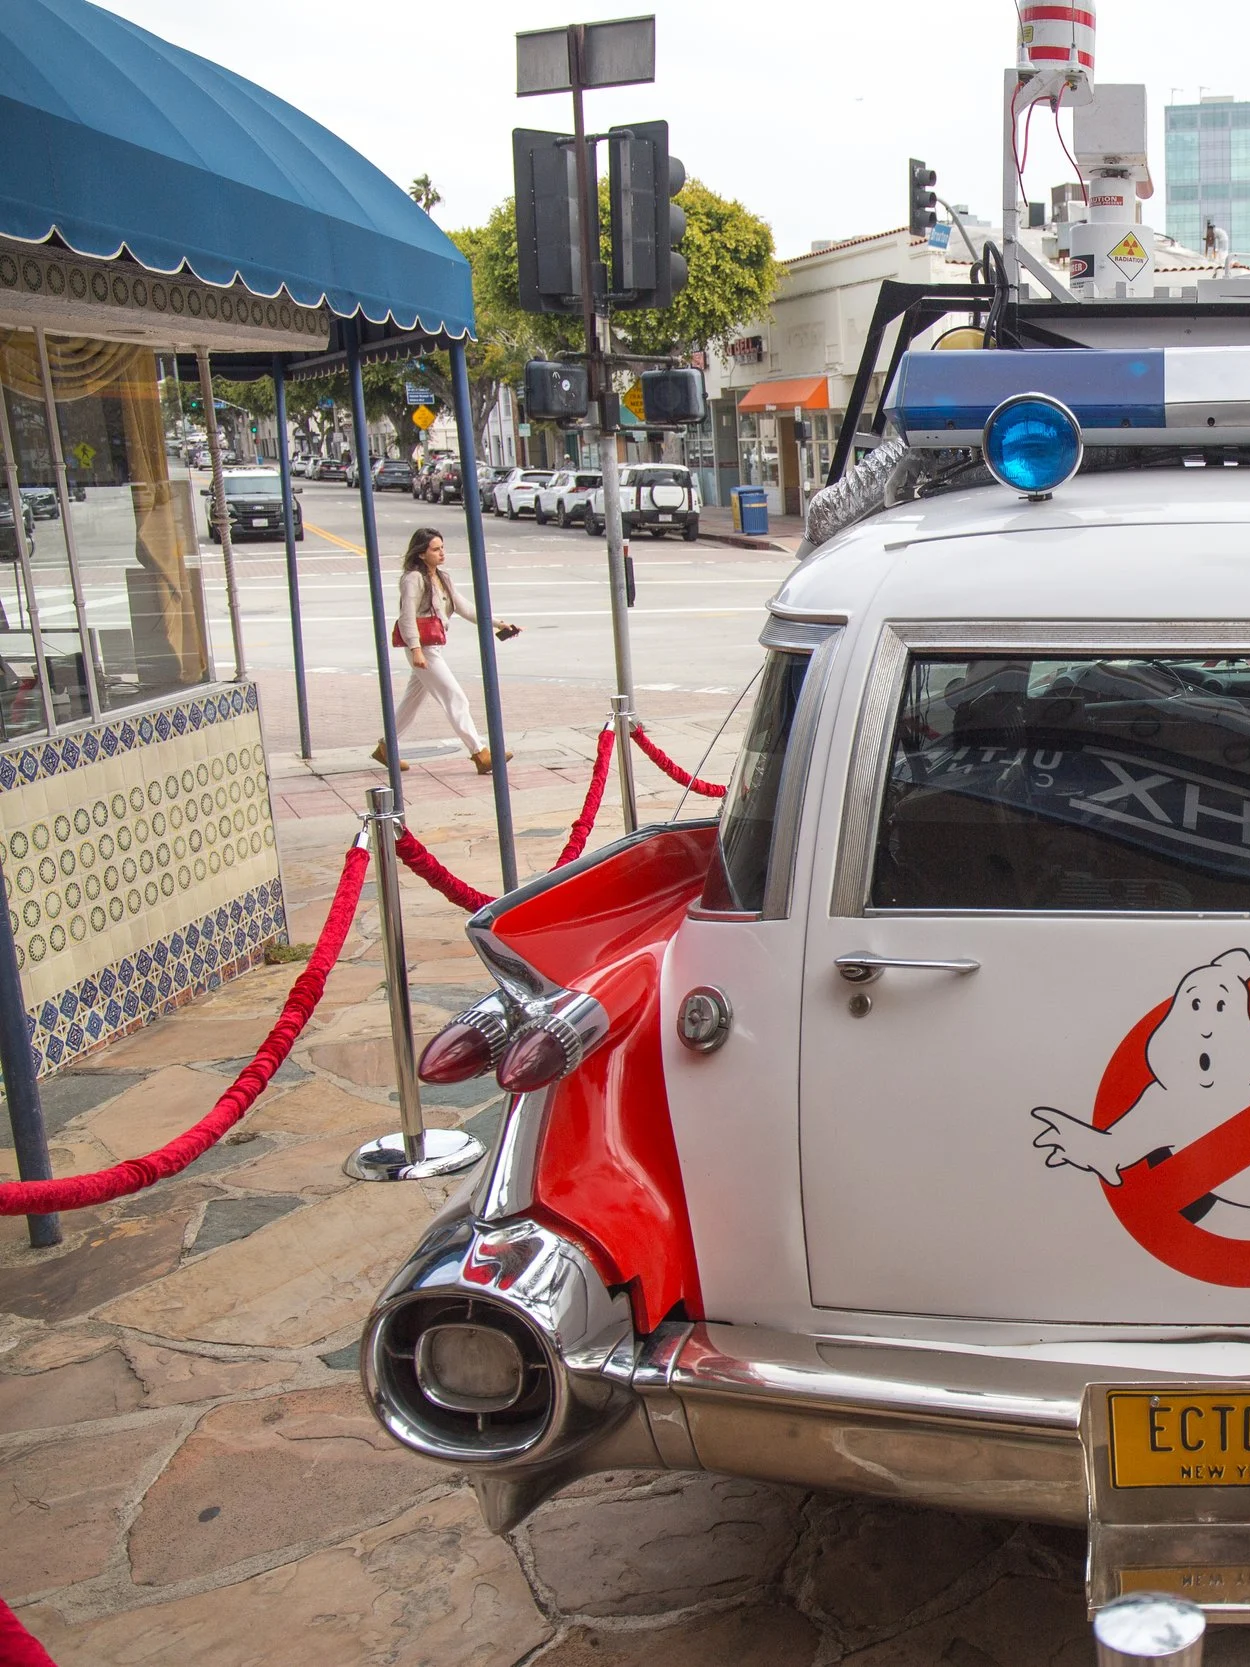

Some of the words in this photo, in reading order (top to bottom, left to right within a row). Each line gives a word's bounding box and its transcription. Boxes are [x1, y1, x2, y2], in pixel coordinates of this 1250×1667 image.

[1114, 256, 1144, 264] RADIATION
[735, 338, 754, 353] BELL
[1181, 1465, 1225, 1479] NEW
